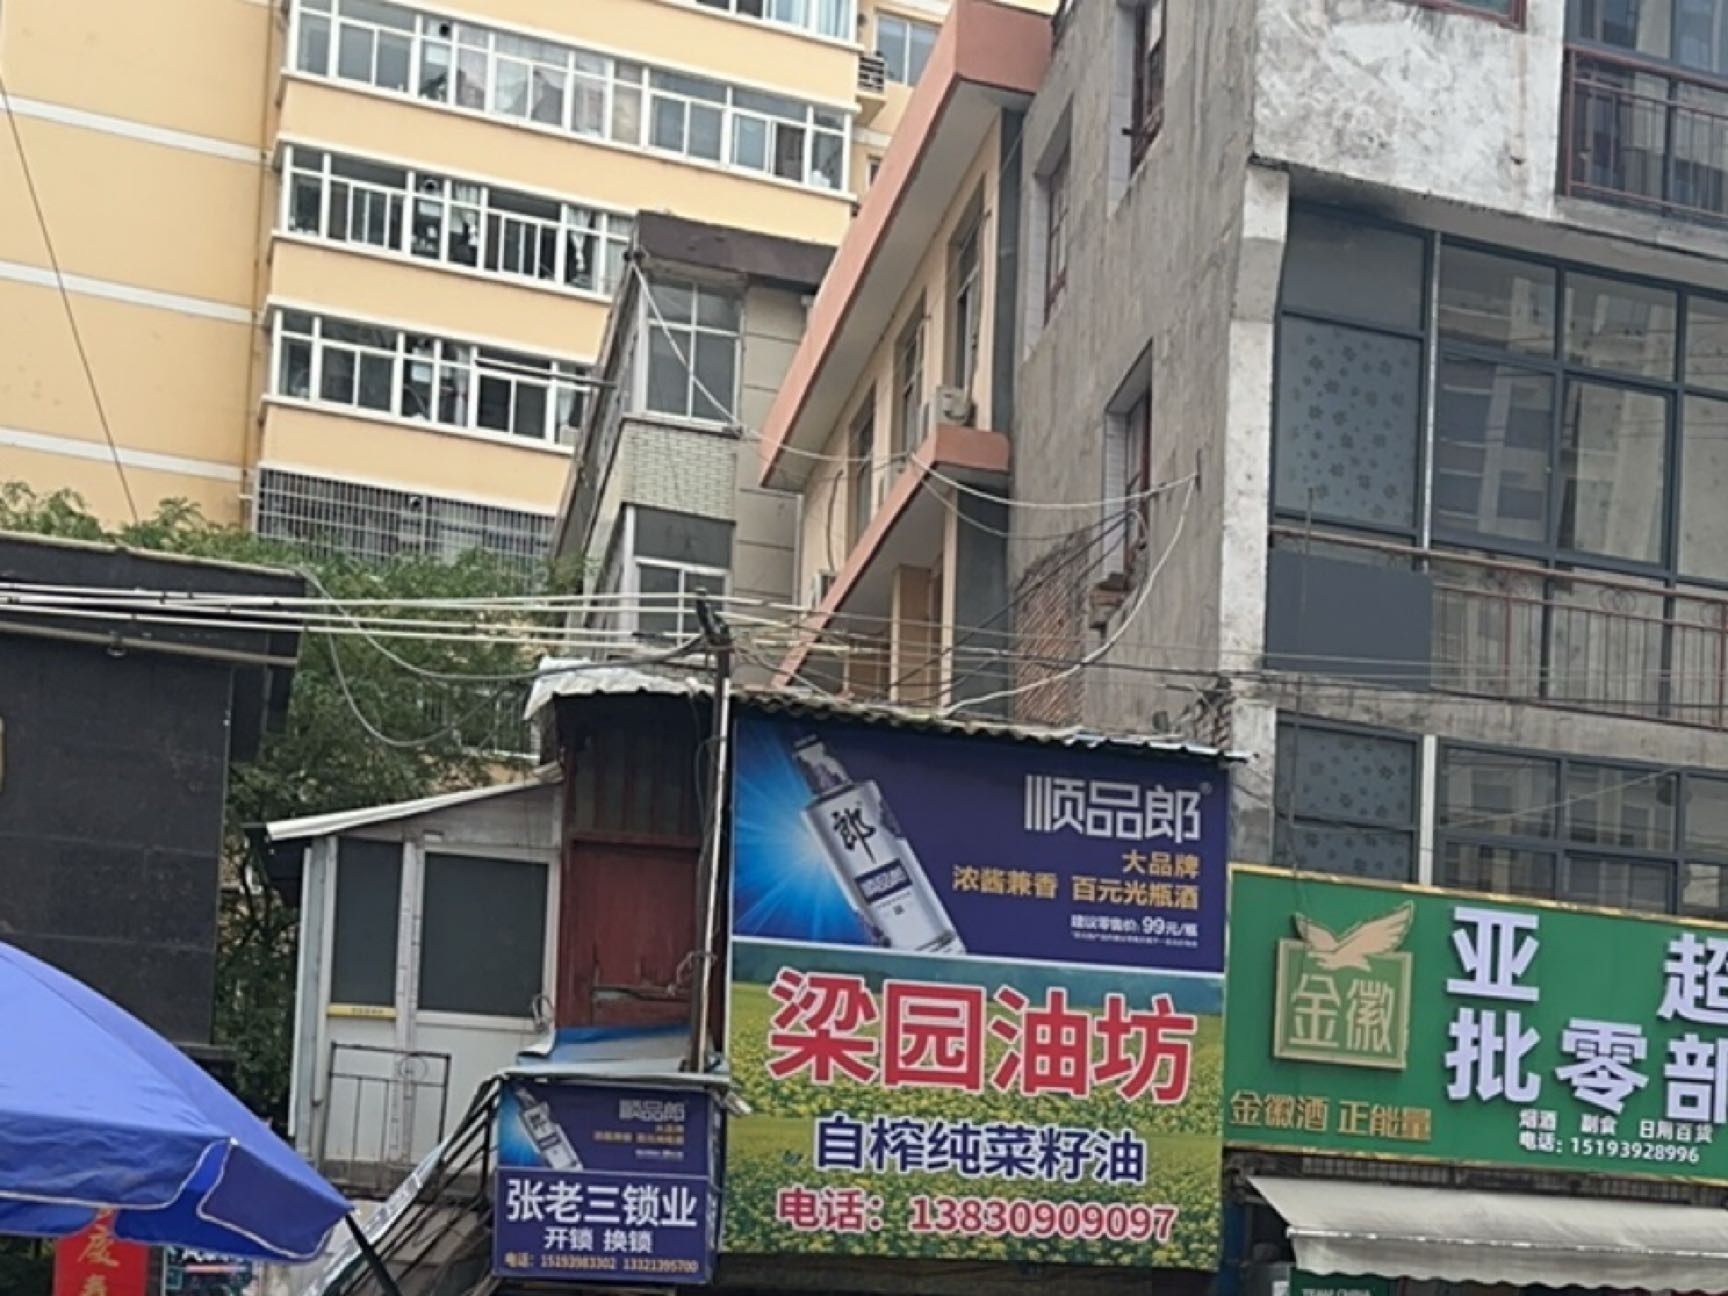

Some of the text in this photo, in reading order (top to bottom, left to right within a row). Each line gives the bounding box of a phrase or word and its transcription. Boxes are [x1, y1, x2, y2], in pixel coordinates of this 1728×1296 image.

[1024, 775, 1201, 842] 顺品郎
[953, 865, 1199, 910] 浓酱兼香 百元光瓶酒
[1123, 851, 1199, 878] 大品牌
[1447, 906, 1540, 1001] 亚
[768, 967, 1196, 1104] 梁园油坊
[1290, 974, 1395, 1056] 金徽
[1230, 1091, 1431, 1141] 金徽酒 正能量
[816, 1115, 1145, 1184] 自榨纯菜籽油
[506, 1179, 697, 1227] 张老三锁业
[911, 1196, 1177, 1241] 13830909097
[544, 1227, 653, 1254] 开锁 换锁
